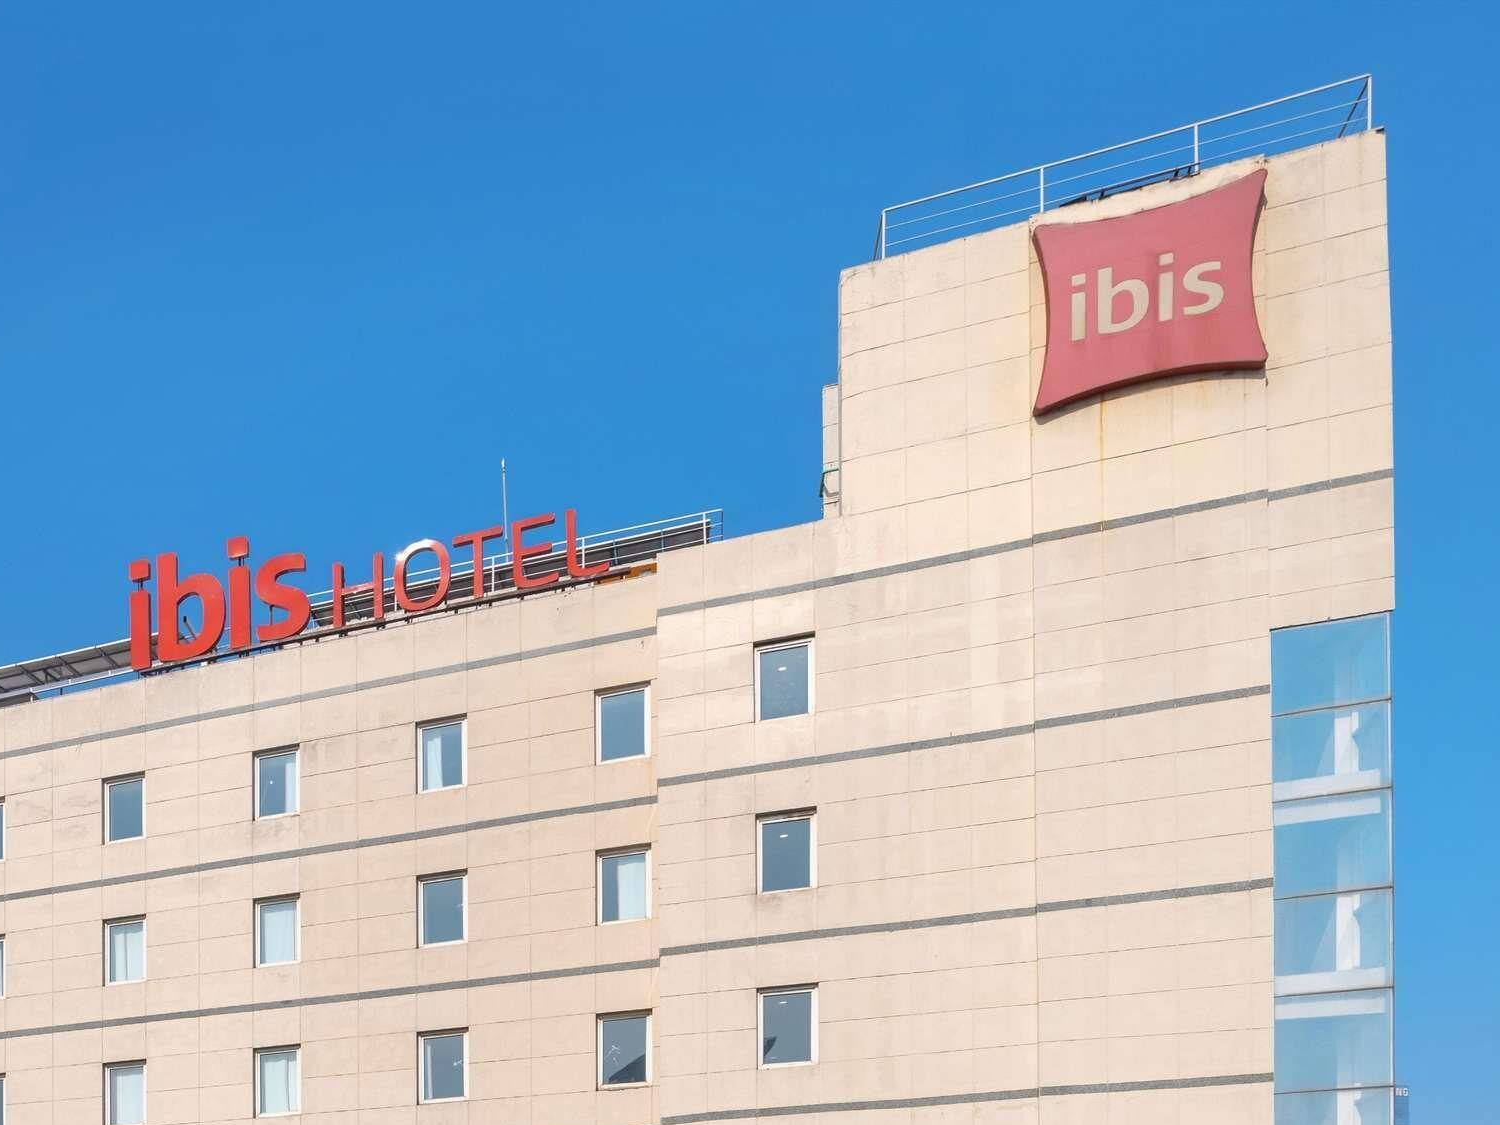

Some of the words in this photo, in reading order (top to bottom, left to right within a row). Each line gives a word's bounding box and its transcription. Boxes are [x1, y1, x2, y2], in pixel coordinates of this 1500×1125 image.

[1071, 252, 1224, 342] ibis
[129, 536, 311, 671] ibis
[332, 508, 610, 628] HOTEL
